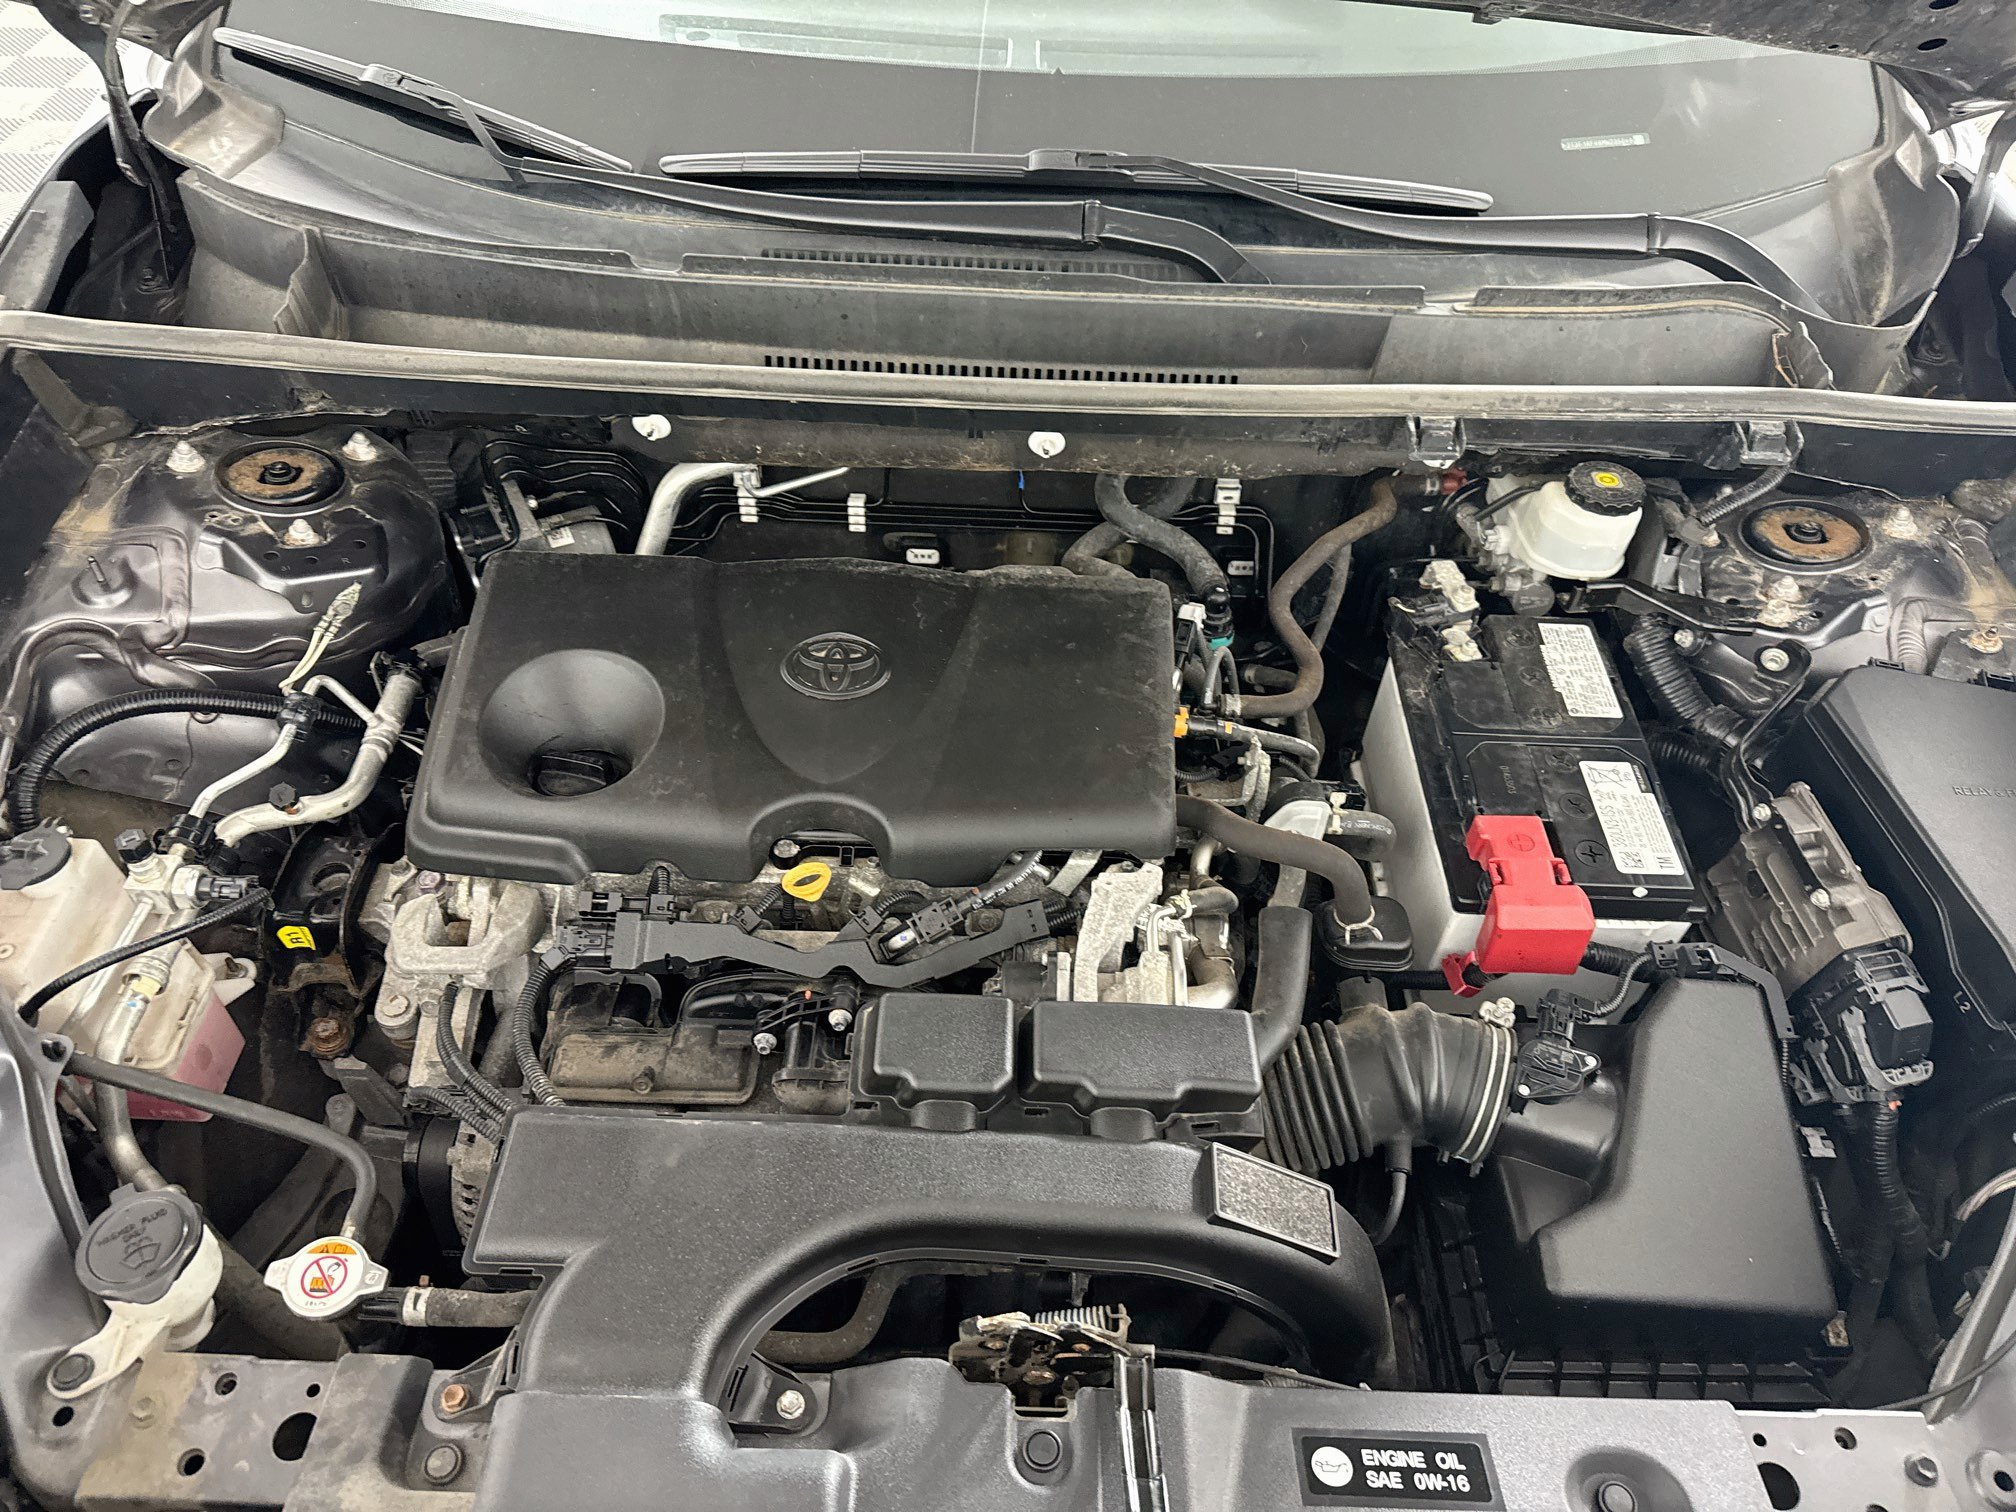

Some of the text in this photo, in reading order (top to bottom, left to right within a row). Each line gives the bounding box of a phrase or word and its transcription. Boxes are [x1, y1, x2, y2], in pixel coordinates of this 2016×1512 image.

[1952, 785, 1993, 797] RELAY
[1360, 1448, 1467, 1470] ENGINE OIL
[1365, 1470, 1471, 1493] SAE 0W-16
